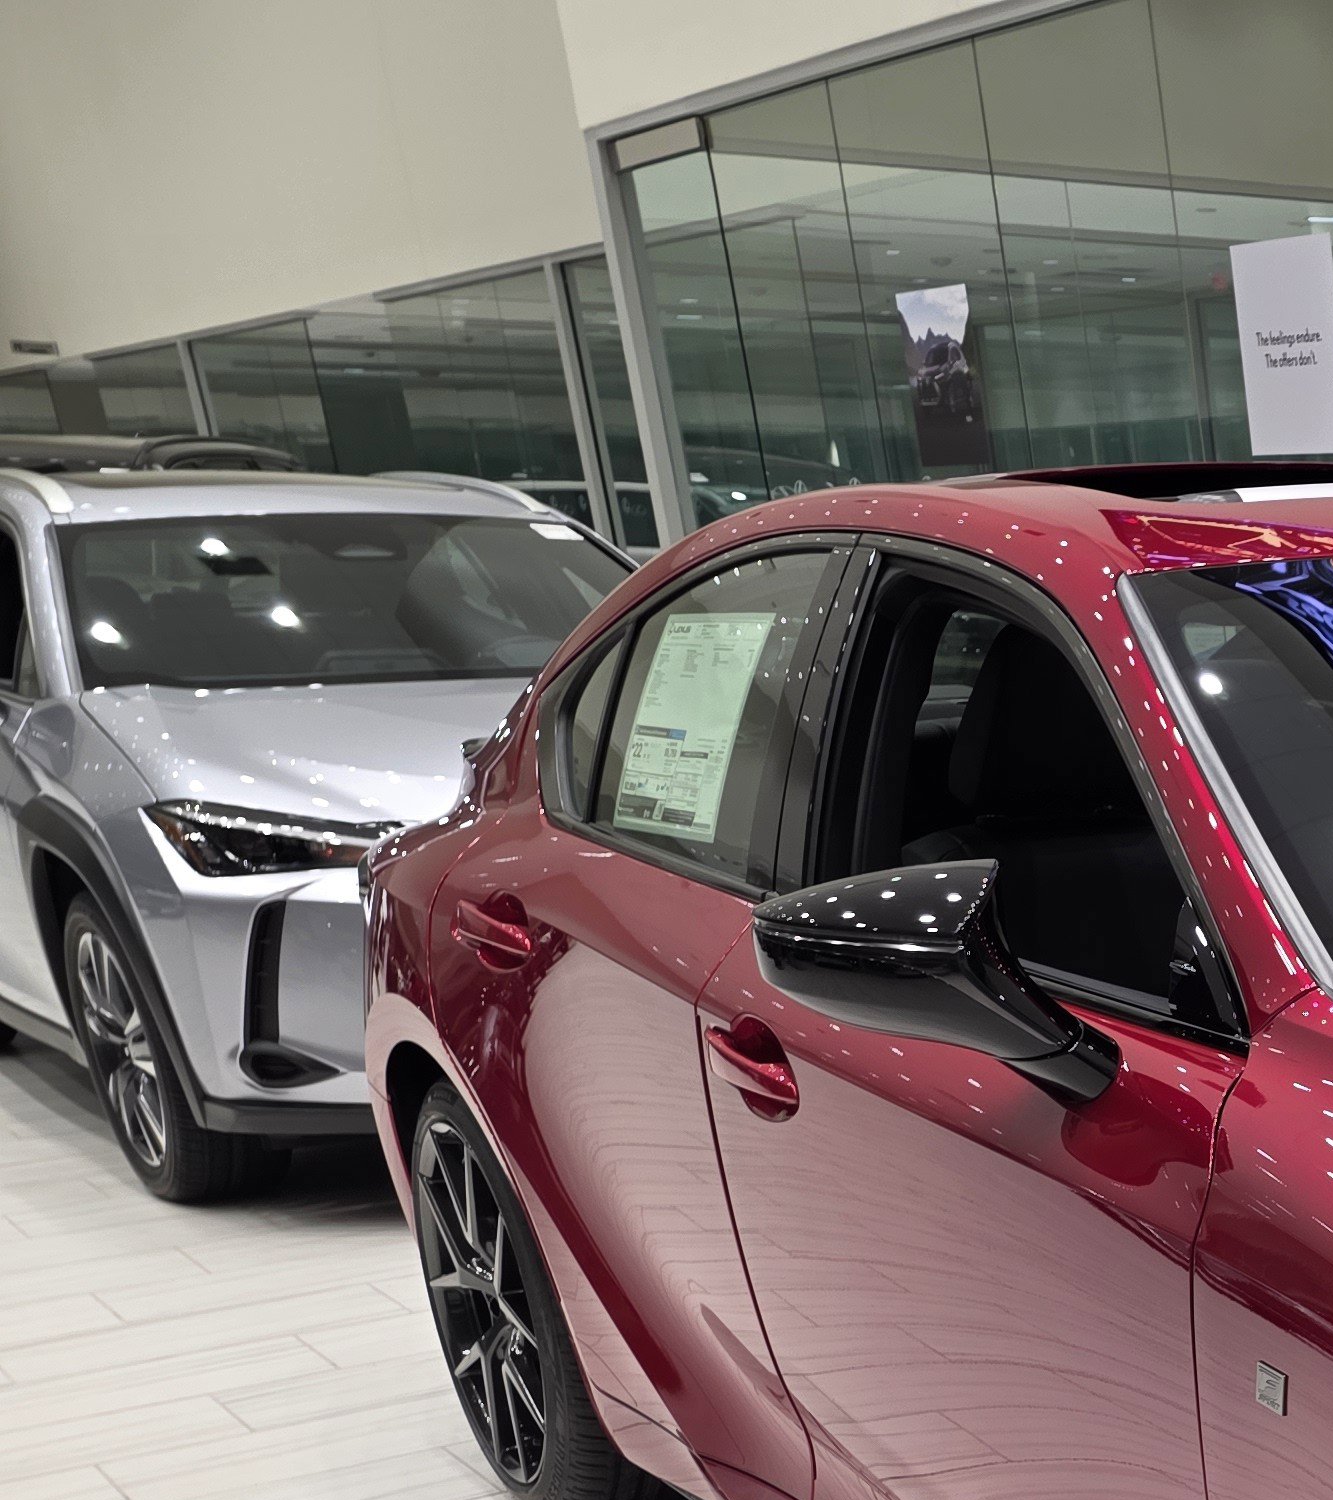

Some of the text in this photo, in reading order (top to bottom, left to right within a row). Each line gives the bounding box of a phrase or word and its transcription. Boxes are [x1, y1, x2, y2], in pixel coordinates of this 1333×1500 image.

[1255, 331, 1269, 347] The
[1269, 329, 1295, 348] feelings
[1264, 353, 1278, 368] The
